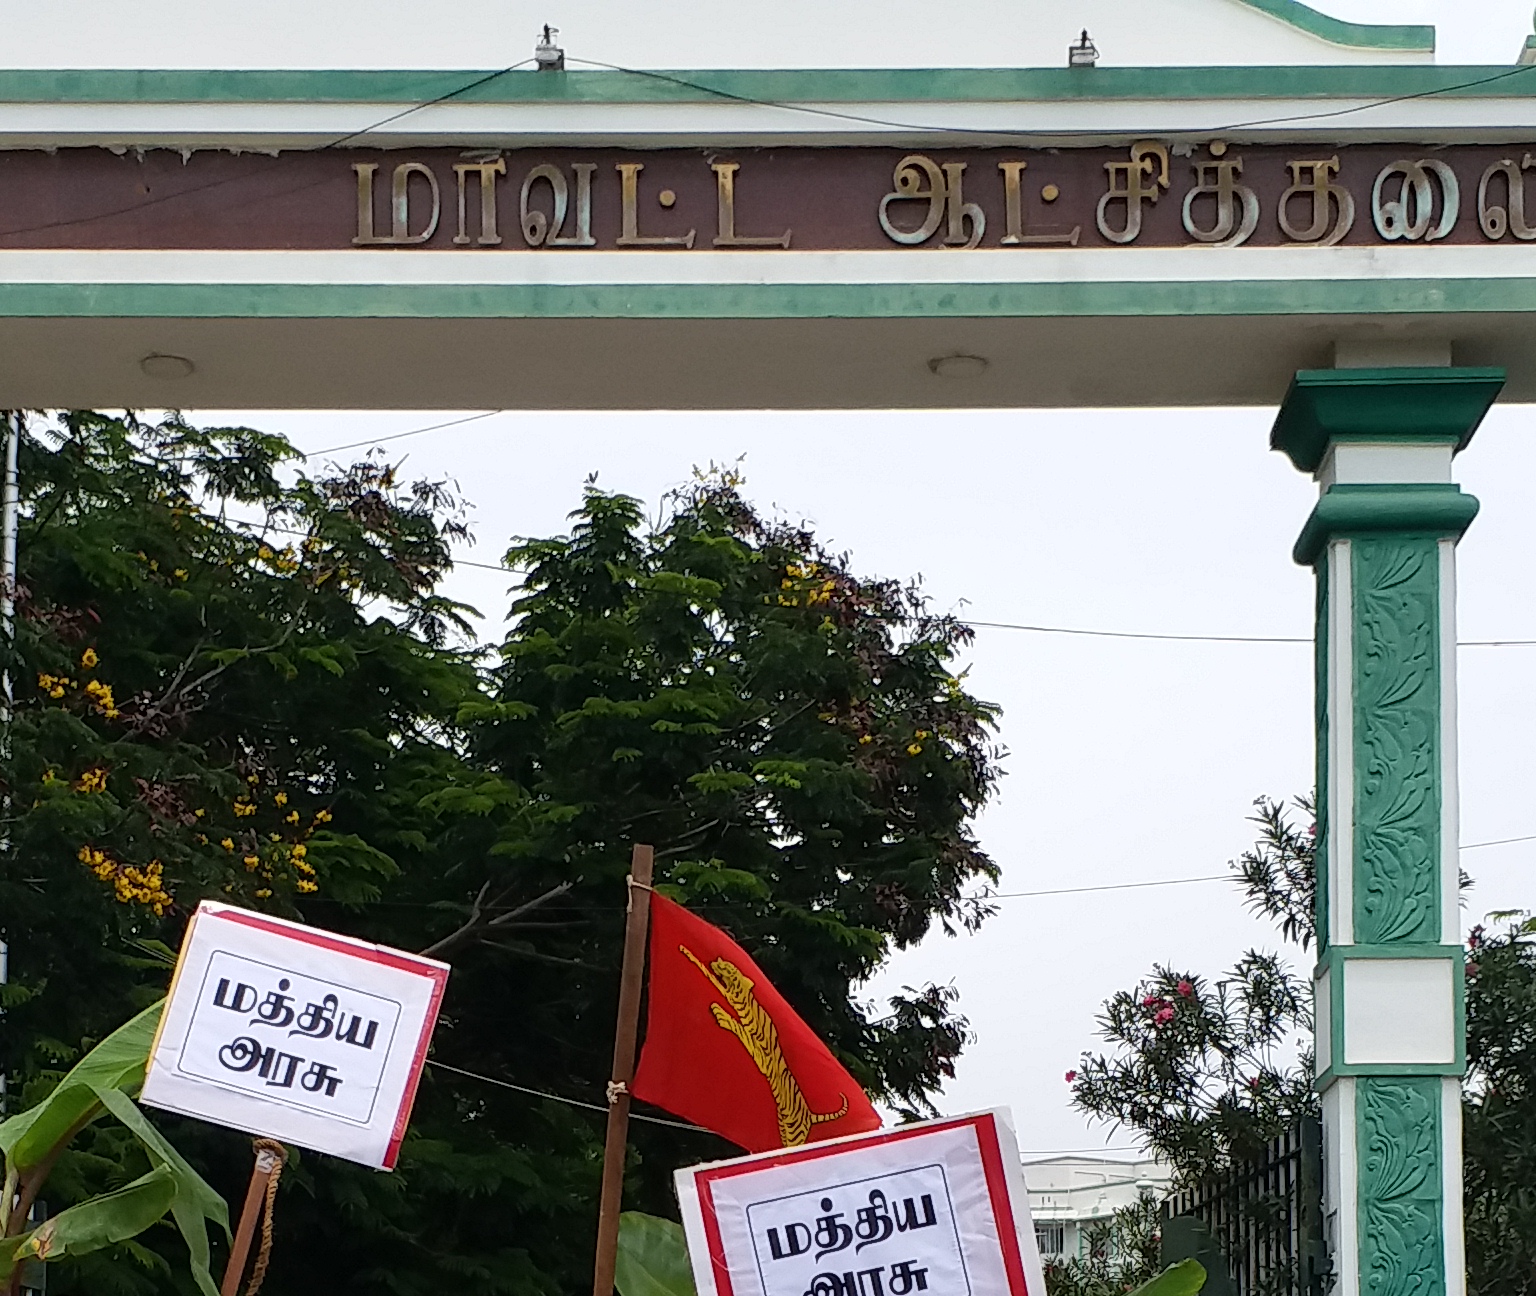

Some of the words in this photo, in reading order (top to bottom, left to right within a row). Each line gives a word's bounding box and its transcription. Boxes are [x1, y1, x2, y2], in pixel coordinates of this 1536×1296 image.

[350, 157, 793, 248] மாவட்ட
[212, 978, 380, 1050] மத்திய
[218, 1036, 344, 1098] அரசு
[766, 1190, 938, 1264] மத்திய
